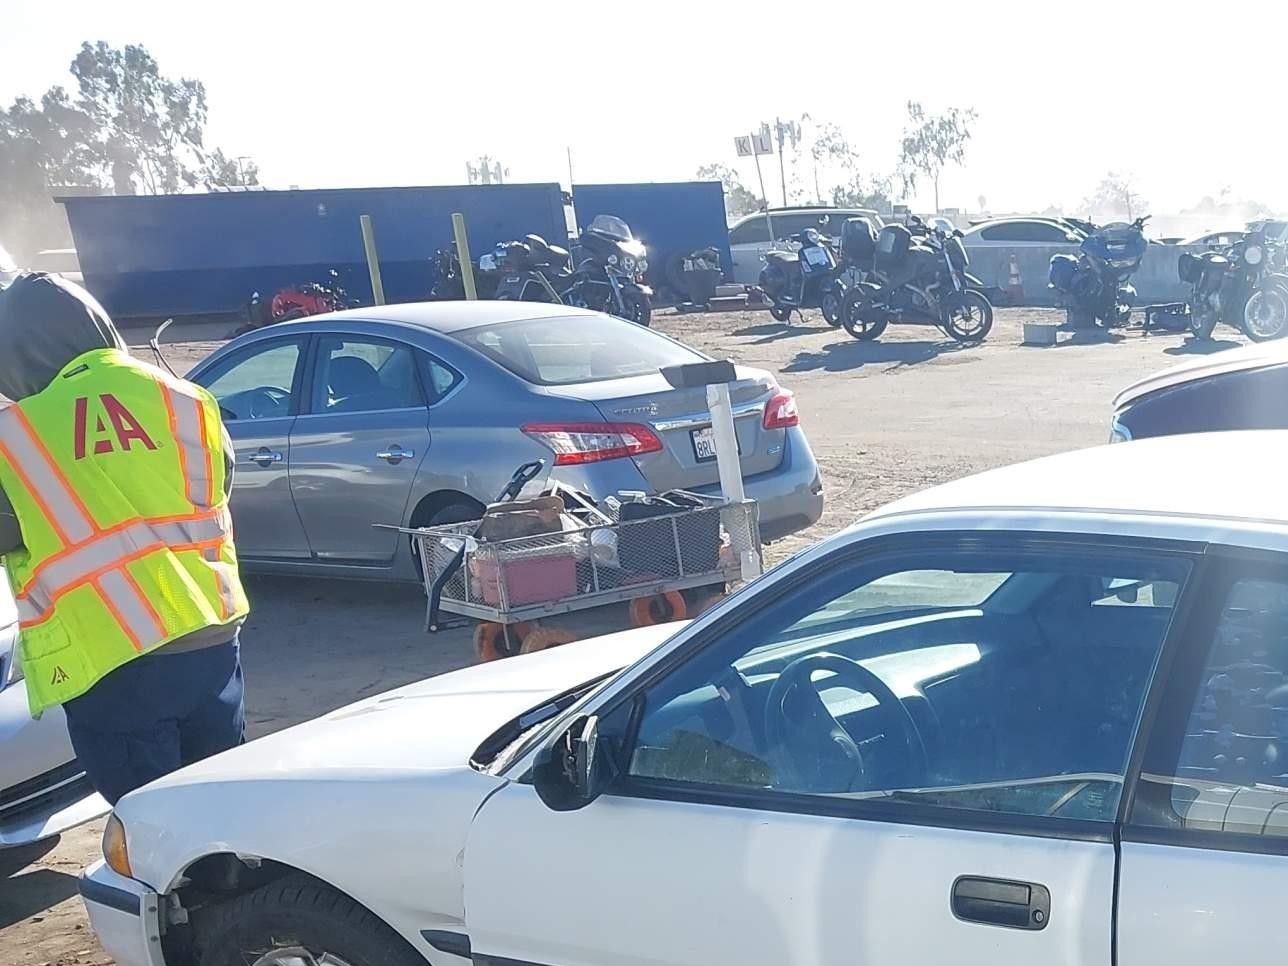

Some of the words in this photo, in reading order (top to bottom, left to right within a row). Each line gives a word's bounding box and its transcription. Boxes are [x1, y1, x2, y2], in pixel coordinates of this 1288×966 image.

[738, 138, 749, 153] K
[760, 137, 769, 152] L
[697, 439, 717, 457] 8RL
